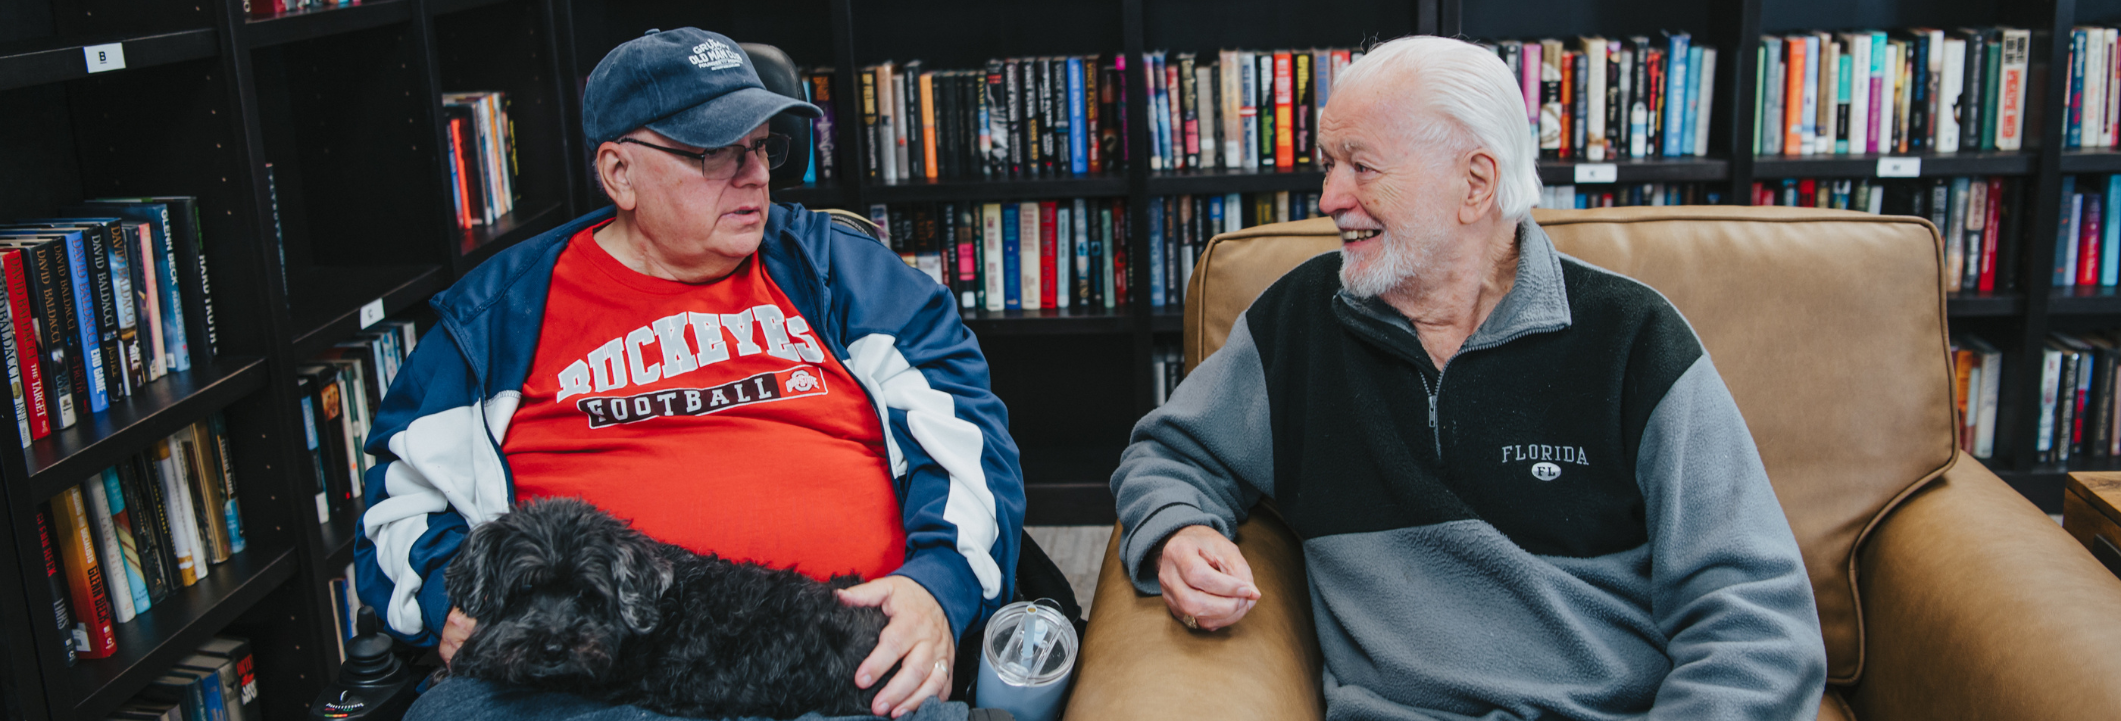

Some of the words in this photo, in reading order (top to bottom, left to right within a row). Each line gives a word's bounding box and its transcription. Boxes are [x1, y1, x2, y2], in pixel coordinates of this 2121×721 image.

[98, 51, 107, 62] B
[688, 53, 709, 65] OLD
[707, 49, 728, 61] MAN
[1007, 64, 1015, 93] VINCE
[1043, 72, 1051, 98] VINCE
[1055, 64, 1063, 90] VINCE
[1009, 94, 1018, 122] FLYNN
[110, 226, 126, 263] DAVID
[161, 209, 174, 252] GLENN
[893, 212, 903, 248] FOLLETT
[904, 220, 912, 240] KEN
[917, 212, 927, 246] FOLLETT
[927, 220, 935, 238] KEN
[36, 249, 51, 284] DAVID
[72, 238, 87, 278] DAVID
[91, 234, 105, 269] DAVID
[10, 256, 25, 295] DAVID
[166, 253, 178, 286] BECK
[96, 273, 114, 327] BALDACCI
[117, 267, 136, 326] BALDACCI
[17, 298, 36, 360] BALDACCI
[43, 288, 61, 344] BALDACCI
[53, 244, 67, 277] DAVID
[60, 279, 76, 330] BALDACCI
[73, 364, 84, 393] TRUTH
[79, 282, 98, 346] BALDACCI
[0, 308, 19, 380] BALDACCI
[91, 348, 102, 367] END
[557, 304, 825, 403] BUCKEYES
[31, 363, 39, 379] THE
[94, 367, 106, 394] GAME
[31, 379, 46, 417] TARGET
[587, 377, 772, 422] FOOTBALL
[1502, 444, 1589, 465] FLORIDA
[1537, 466, 1556, 477] FL
[80, 528, 95, 564] SOCIALISTS
[87, 566, 105, 598] GLENN
[53, 598, 70, 630] LIARS
[94, 598, 111, 624] BECK
